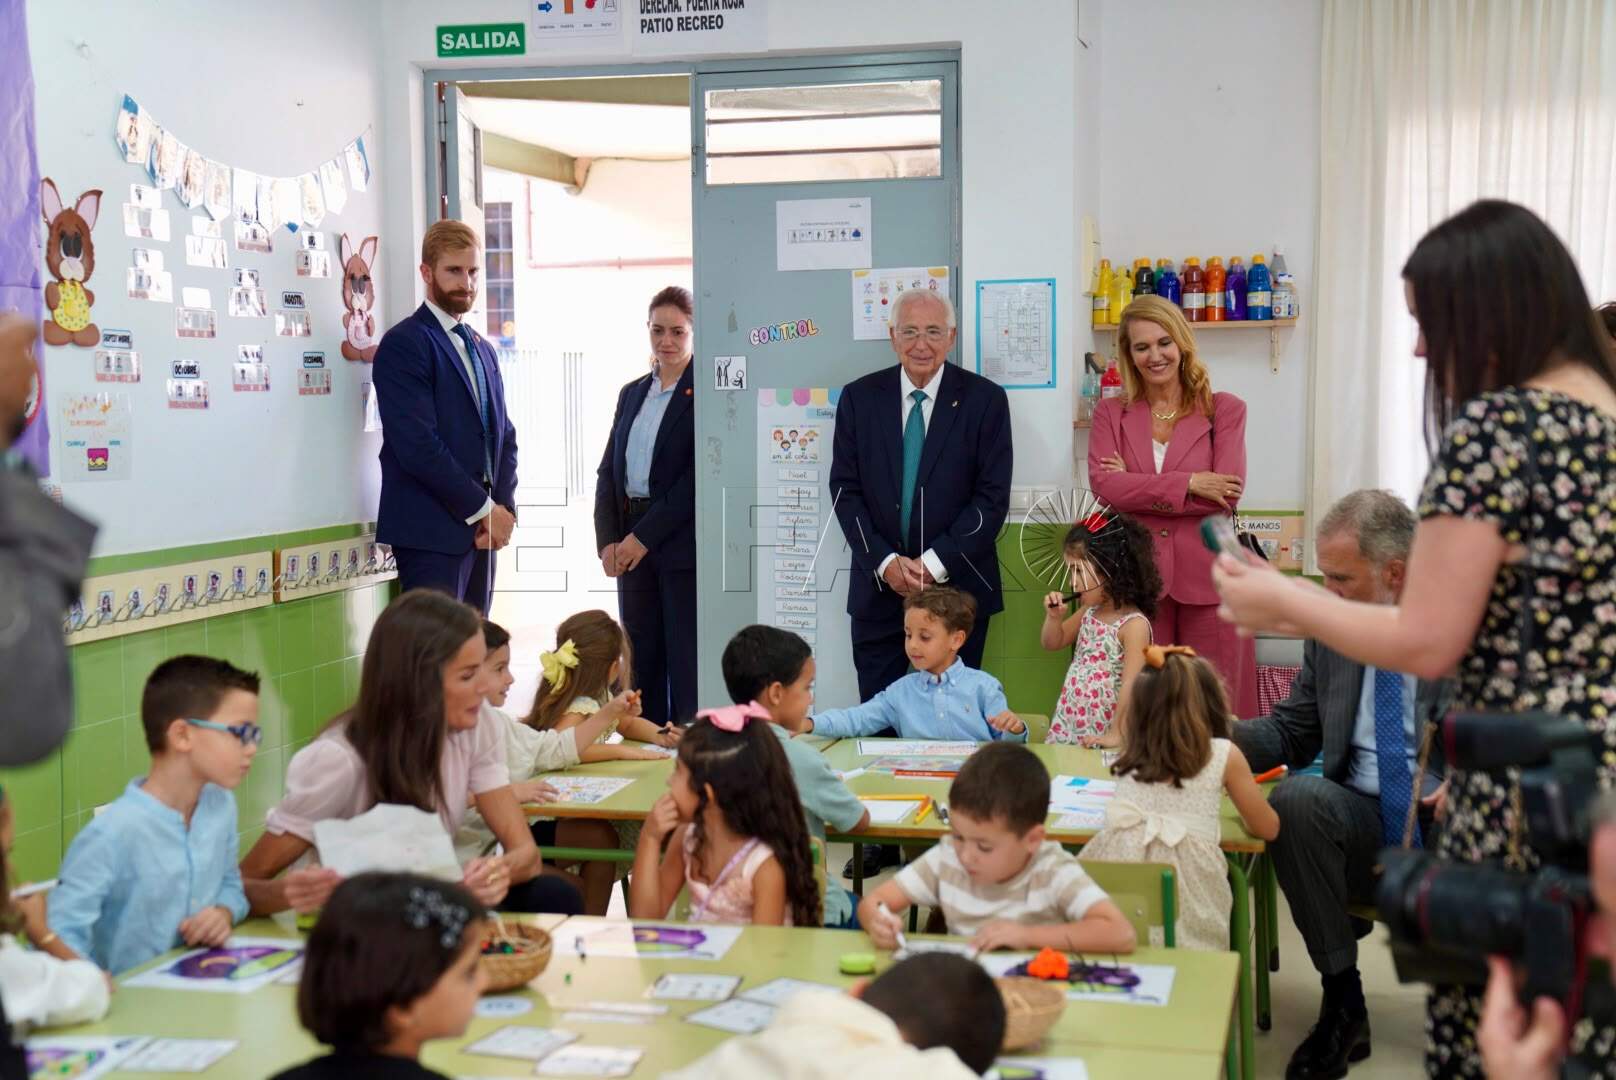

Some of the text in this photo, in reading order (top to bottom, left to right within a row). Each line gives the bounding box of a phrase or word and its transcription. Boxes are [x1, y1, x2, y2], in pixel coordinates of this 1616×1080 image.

[640, 14, 724, 34] PATIO RECREO
[441, 31, 521, 50] SALIDA
[749, 318, 820, 346] CONTROL
[1248, 522, 1281, 531] MANOS
